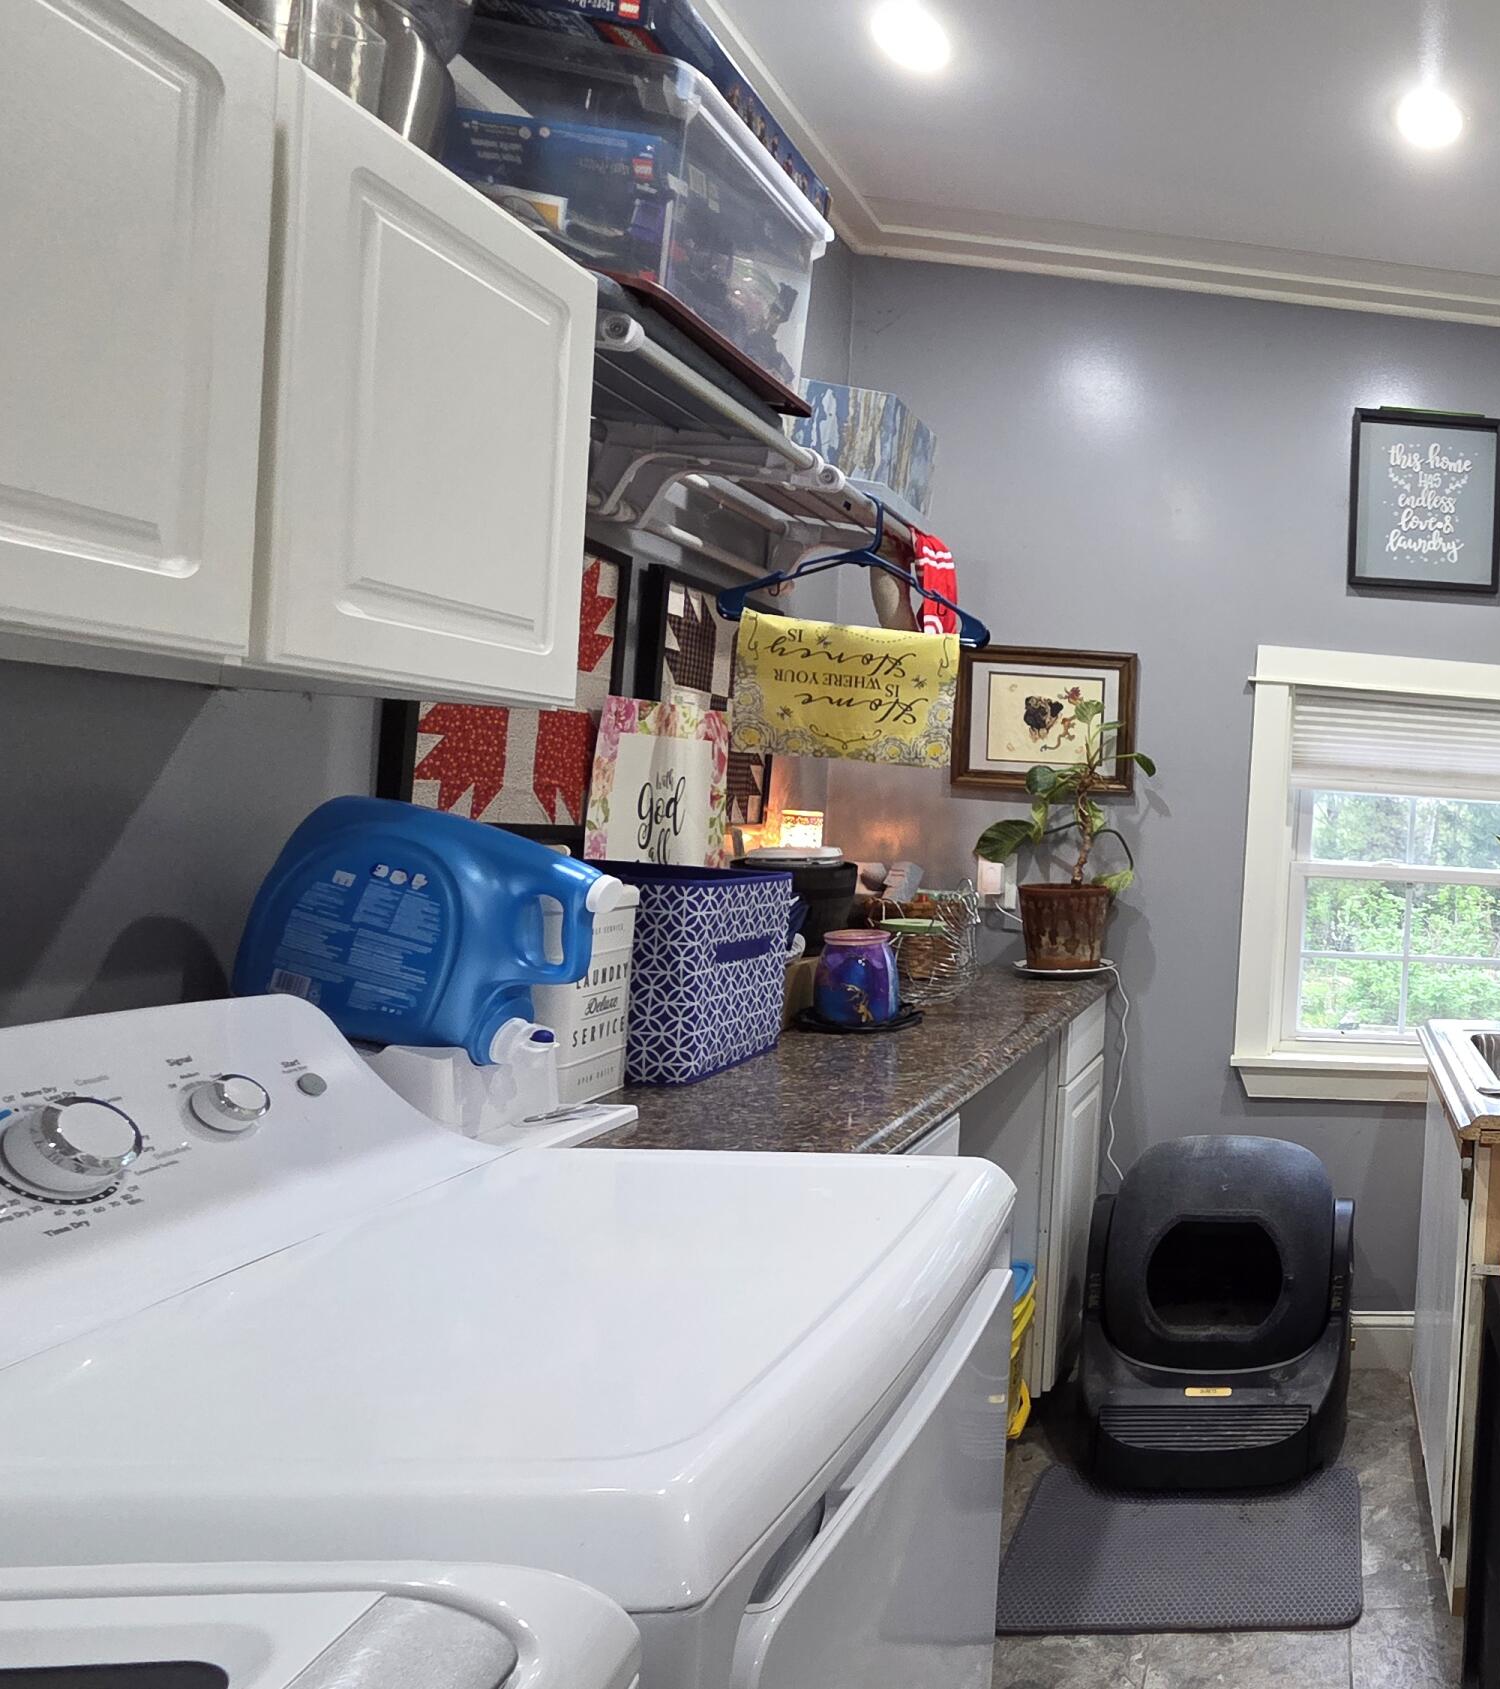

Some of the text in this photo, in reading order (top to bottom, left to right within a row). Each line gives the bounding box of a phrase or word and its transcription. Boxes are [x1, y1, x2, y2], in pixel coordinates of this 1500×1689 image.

[1388, 443, 1472, 473] this home
[1418, 471, 1442, 489] HAS
[1398, 487, 1457, 514] endless
[1385, 529, 1464, 563] laundry
[786, 628, 803, 643] IS
[763, 636, 916, 678] Honey
[773, 668, 900, 698] IS WHERE YOUR
[794, 692, 928, 725] Home
[637, 776, 686, 849] god
[575, 962, 629, 990] LAUNDRY
[584, 995, 618, 1016] Deluxe
[572, 1015, 626, 1048] SERVICE
